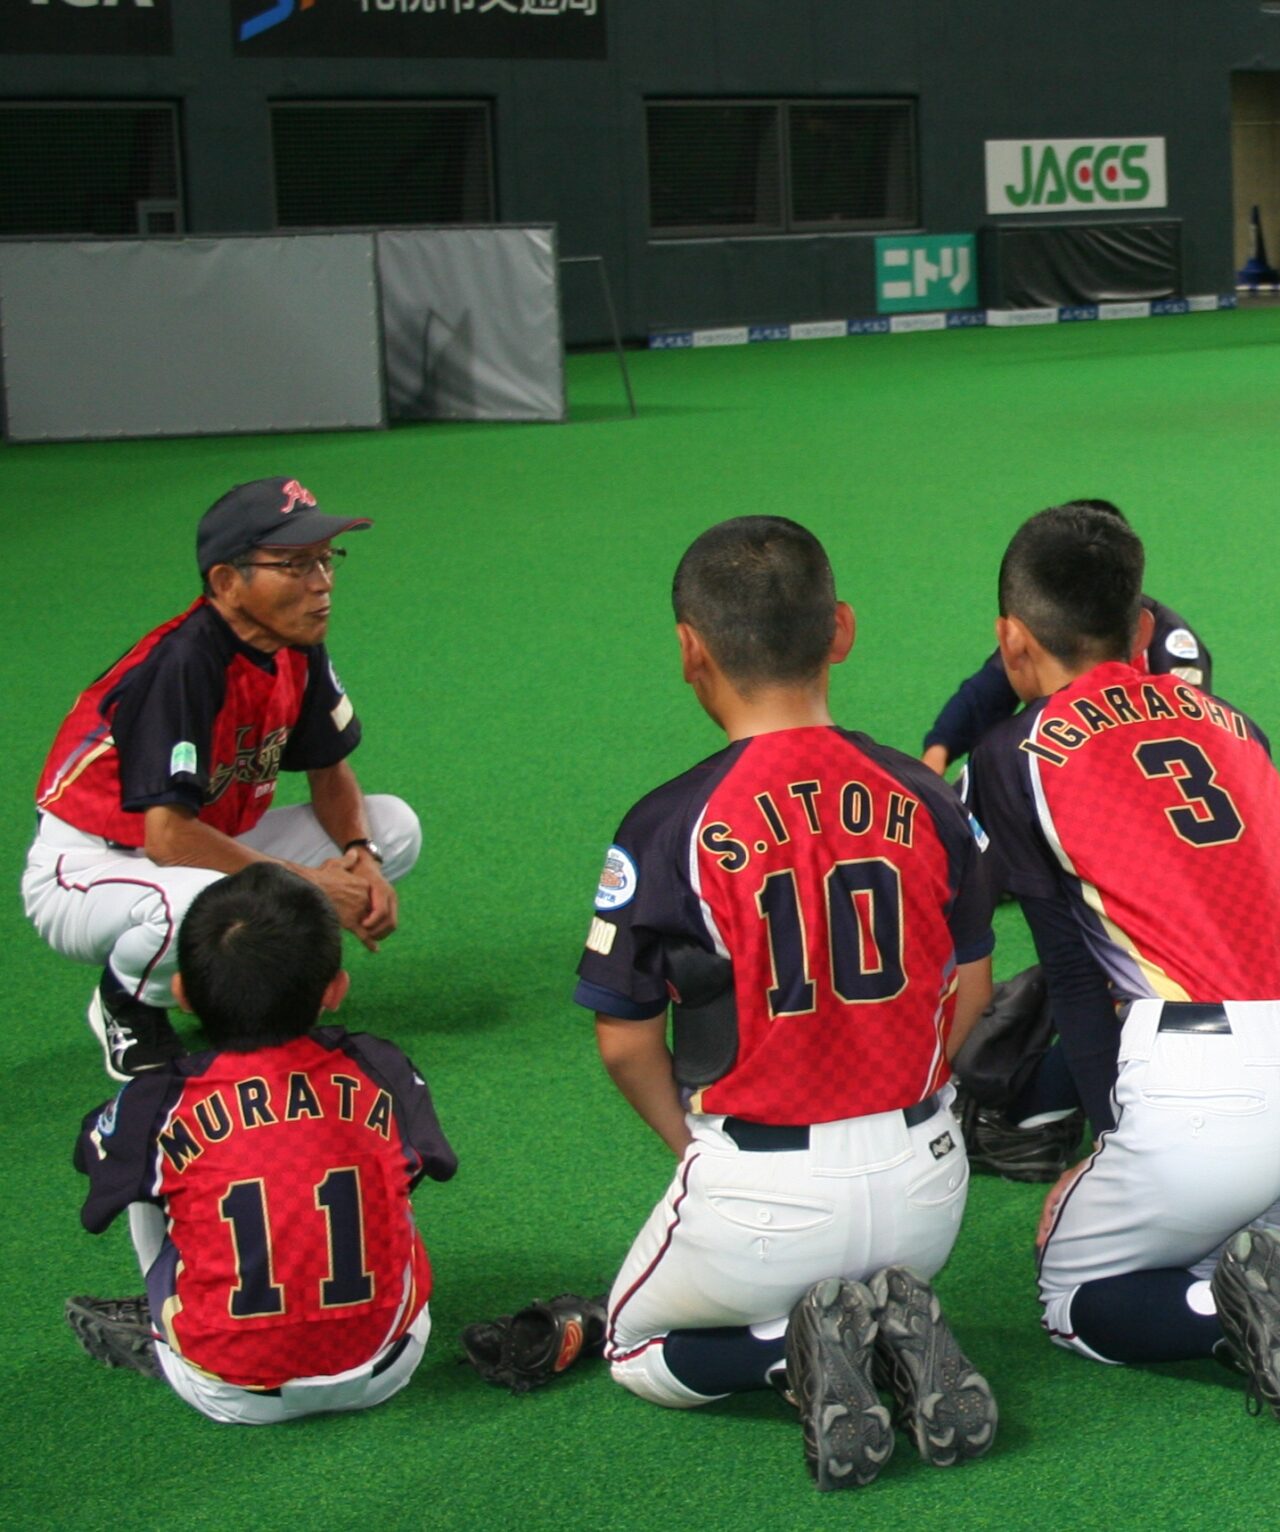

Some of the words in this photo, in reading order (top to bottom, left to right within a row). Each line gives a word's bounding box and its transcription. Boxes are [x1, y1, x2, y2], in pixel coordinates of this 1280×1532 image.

[1004, 144, 1150, 206] JACCS
[882, 246, 972, 299] ニトリ
[1018, 683, 1249, 768] IGARASHI
[699, 779, 918, 873] S.ITOH
[1132, 736, 1246, 848] 3
[754, 855, 909, 1021] 10
[155, 1071, 393, 1174] MURATA
[218, 1166, 376, 1319] 11
